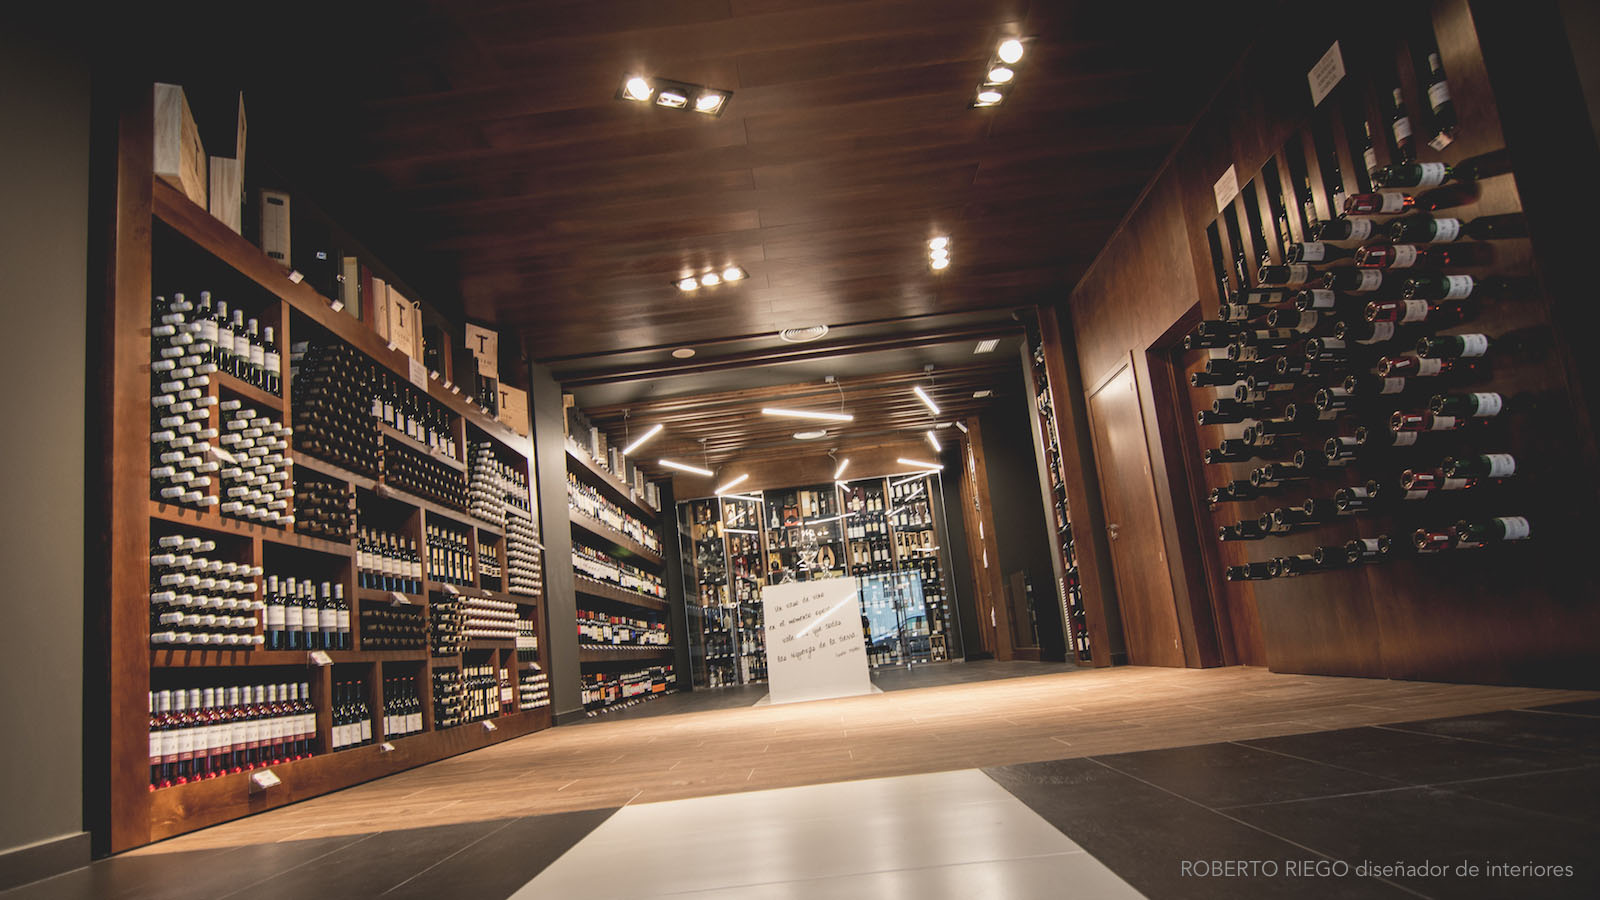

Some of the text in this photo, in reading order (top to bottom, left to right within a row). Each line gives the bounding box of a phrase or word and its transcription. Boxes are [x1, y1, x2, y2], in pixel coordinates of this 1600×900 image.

[395, 301, 405, 328] T
[475, 334, 488, 354] T
[499, 391, 508, 409] T
